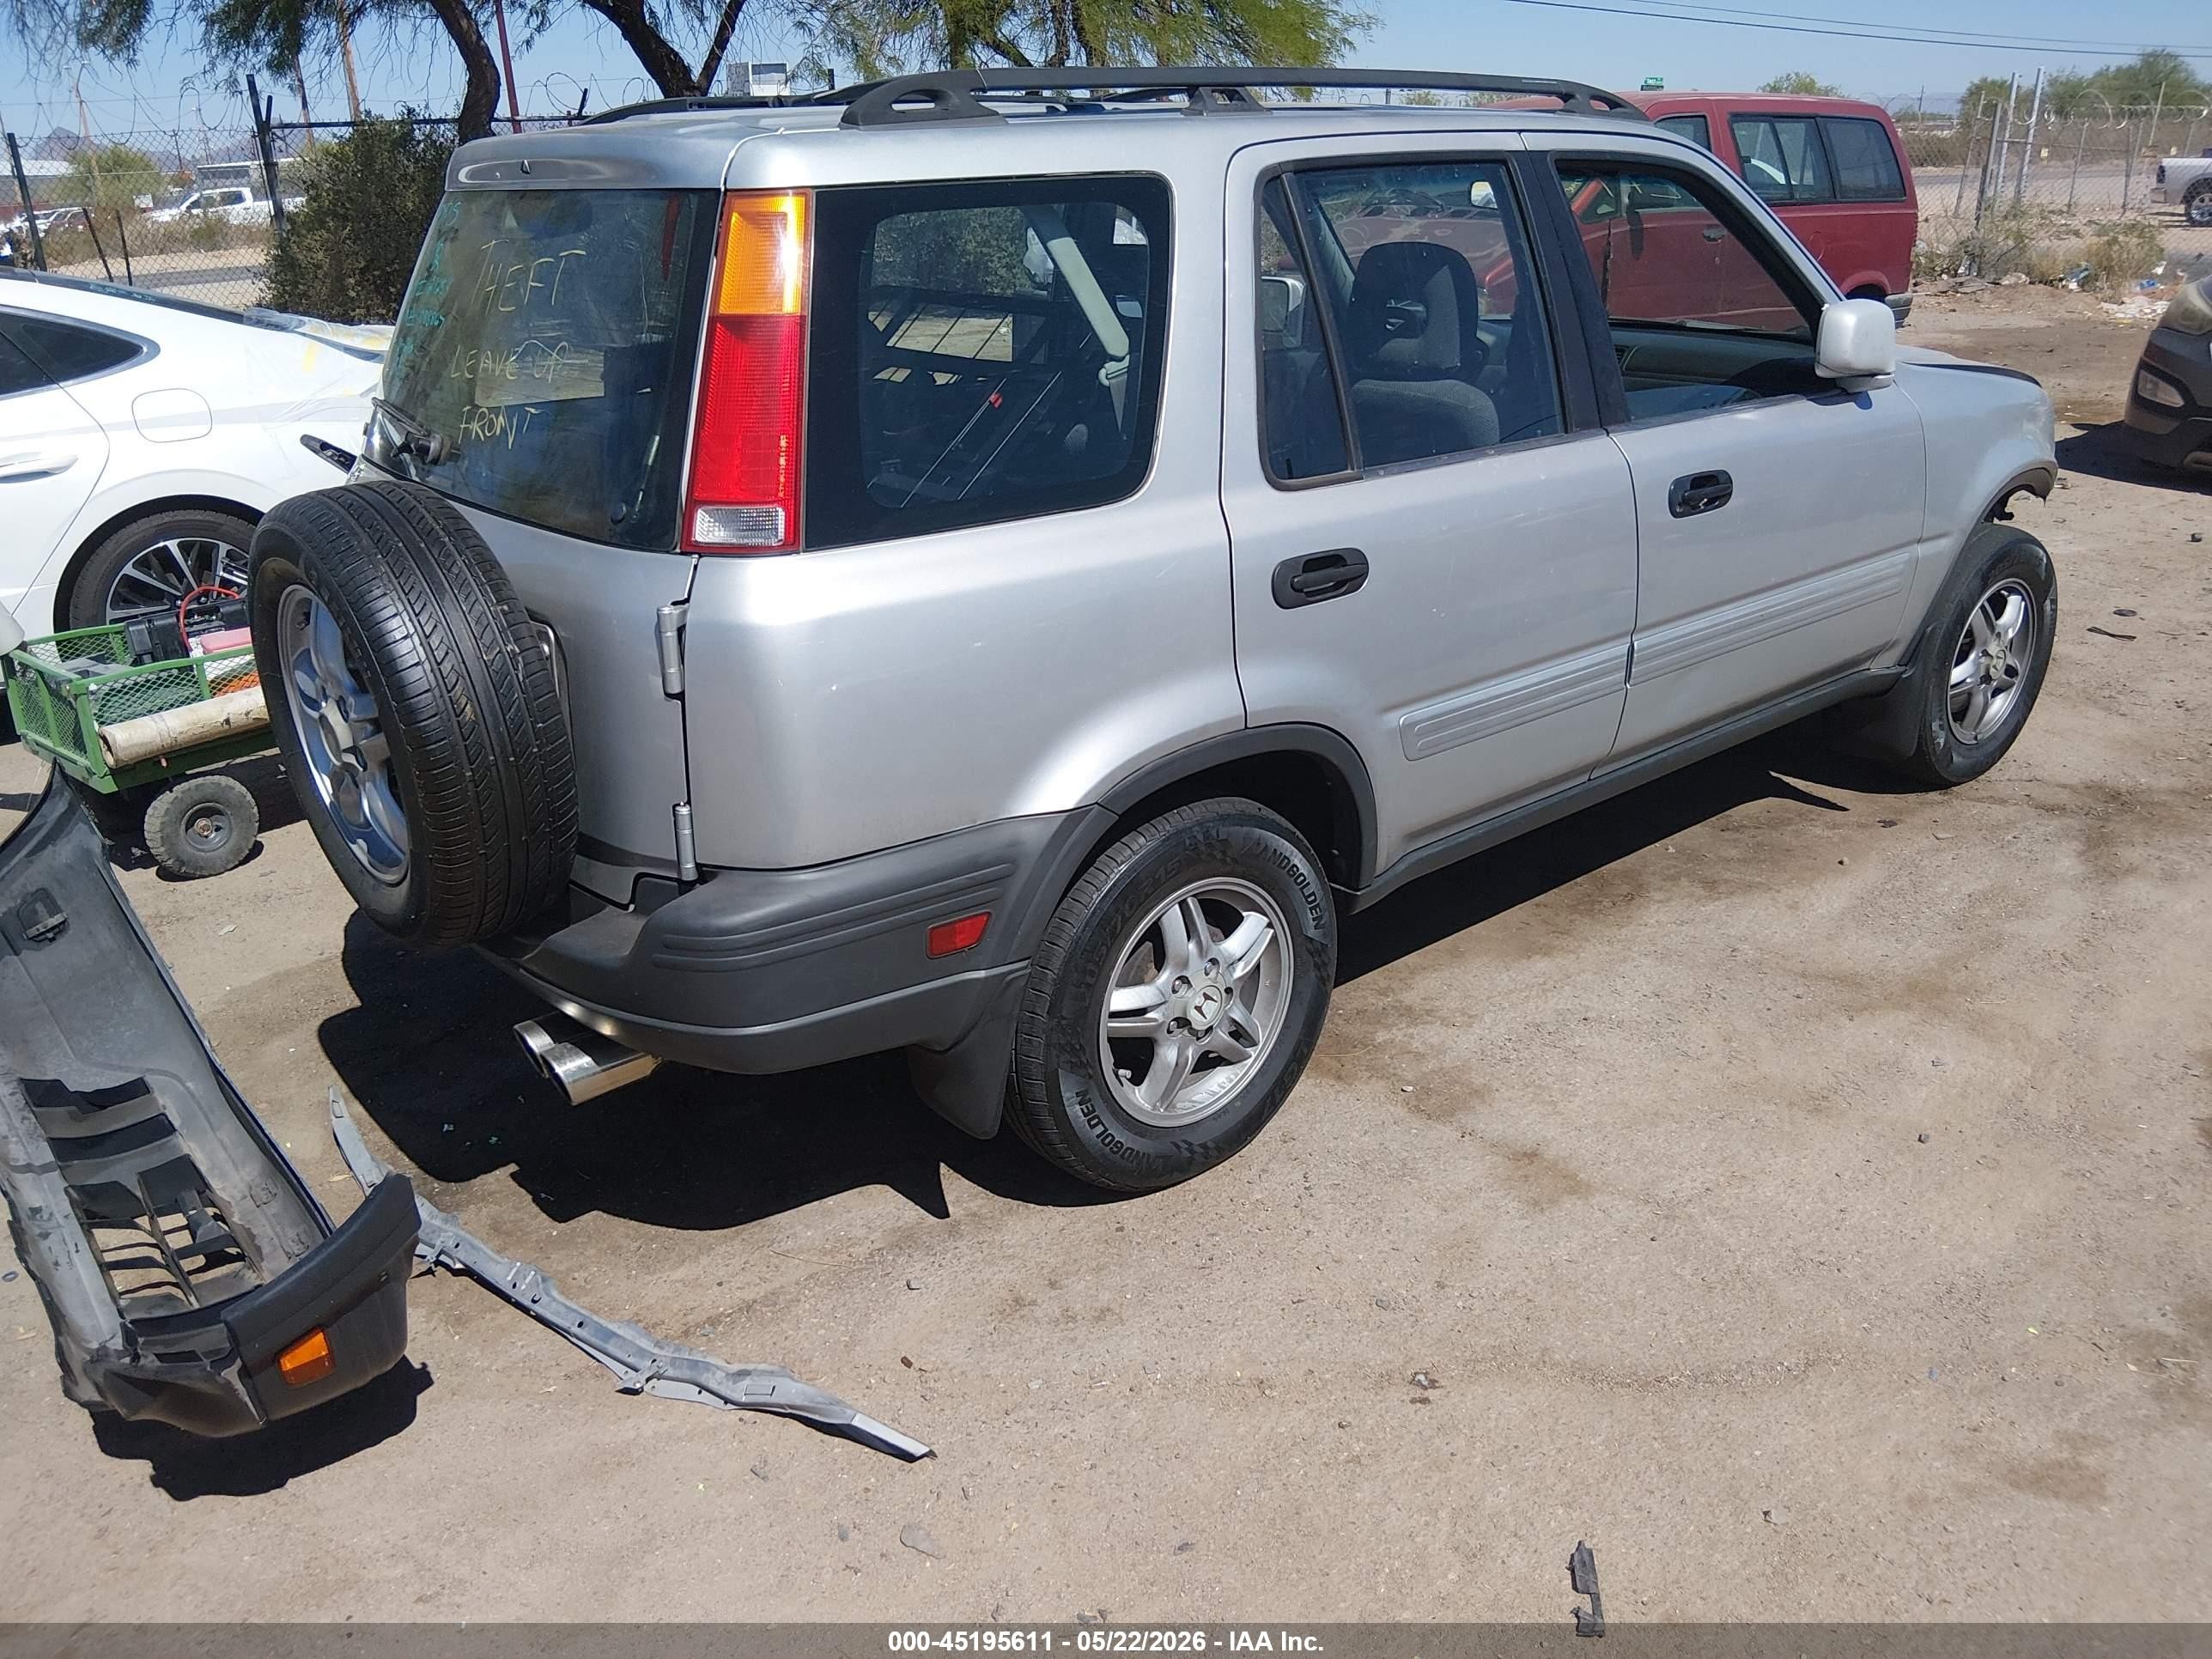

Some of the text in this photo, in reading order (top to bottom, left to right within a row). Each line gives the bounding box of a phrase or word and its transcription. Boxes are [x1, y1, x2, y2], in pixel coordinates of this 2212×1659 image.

[473, 239, 586, 317] THEFT
[451, 343, 520, 380] LEAVE
[458, 404, 548, 450] FRONT
